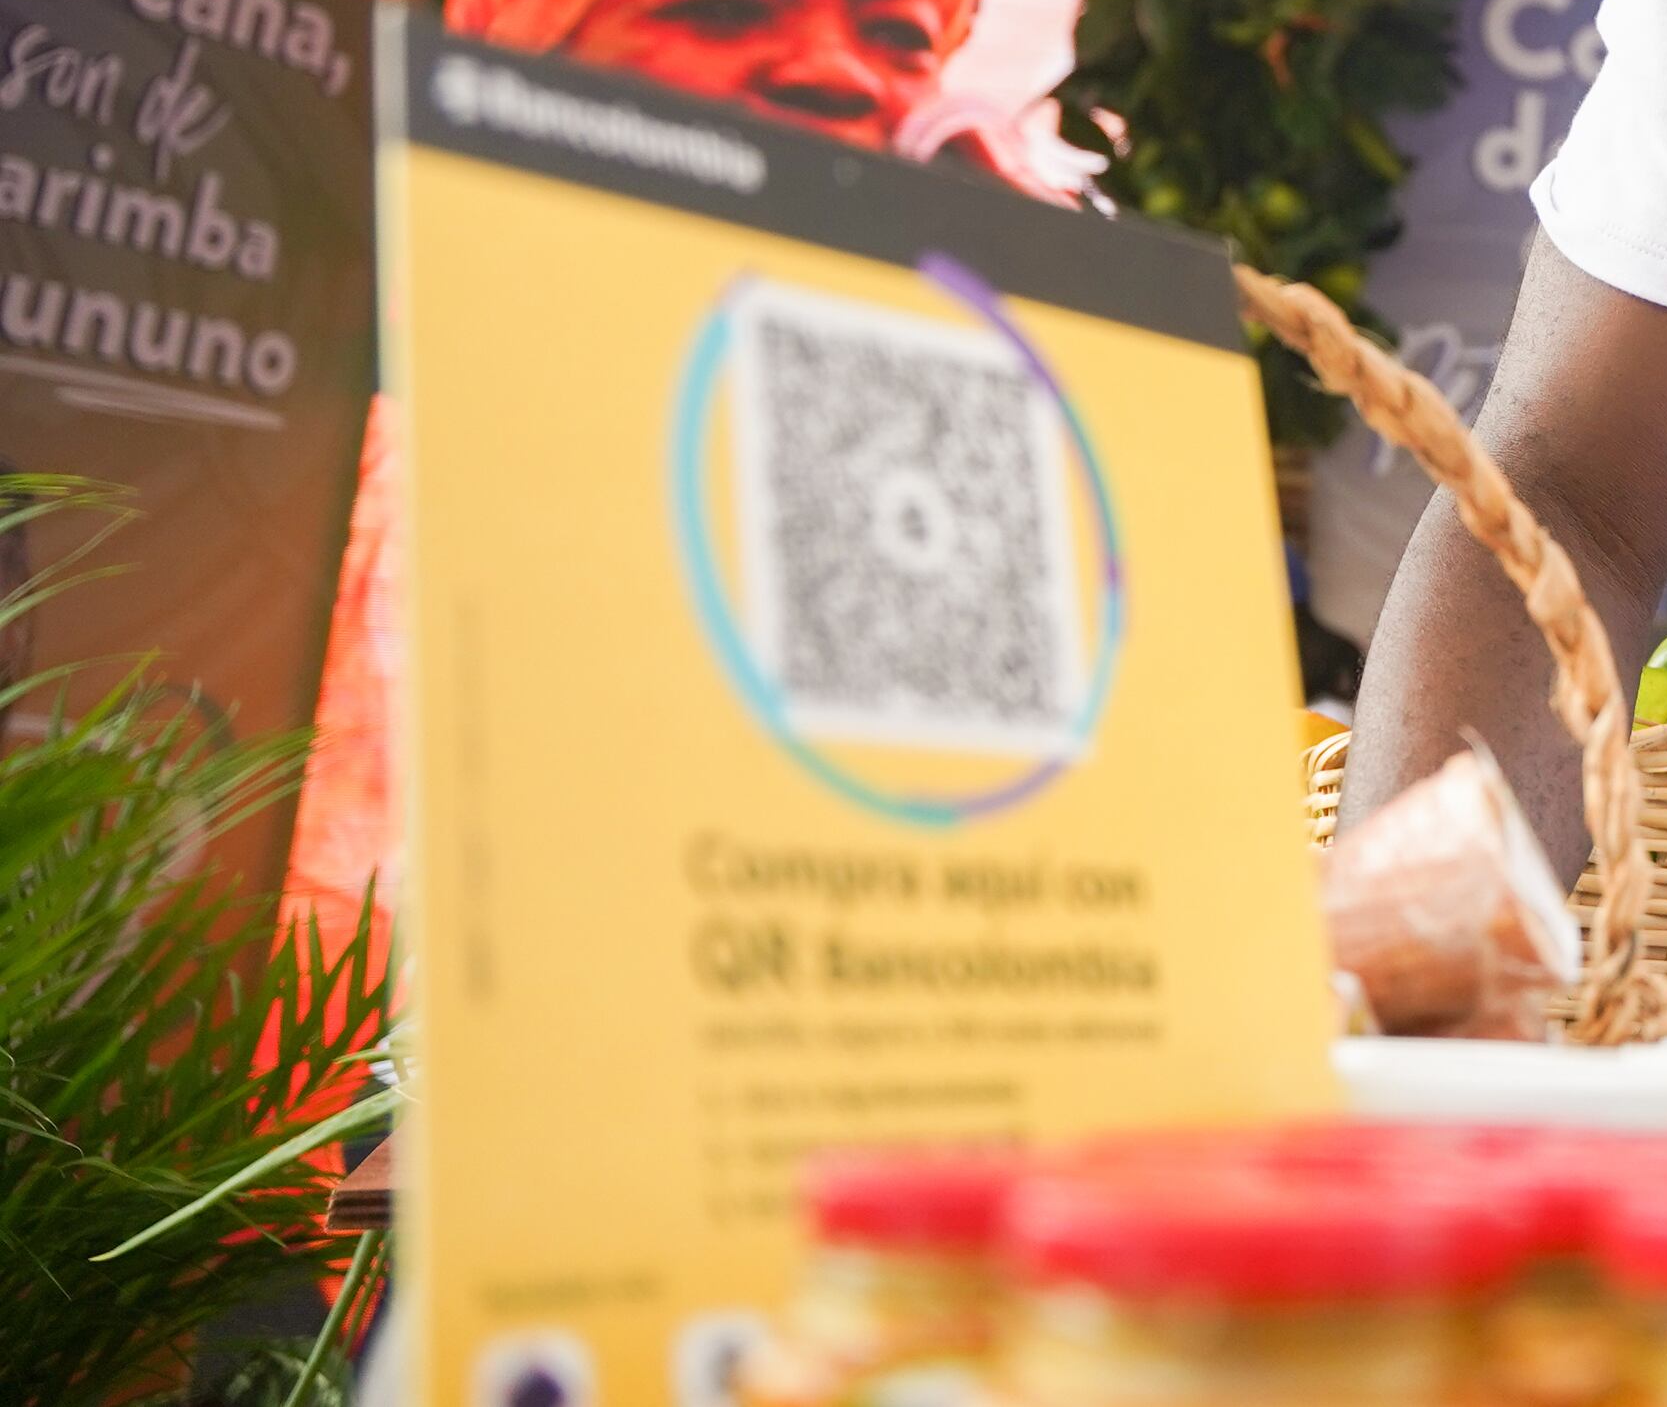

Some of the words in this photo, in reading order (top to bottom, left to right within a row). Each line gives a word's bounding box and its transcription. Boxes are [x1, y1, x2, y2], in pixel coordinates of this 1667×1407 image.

[135, 37, 232, 183] de
[0, 144, 280, 282] arimba
[1, 273, 298, 396] ununo
